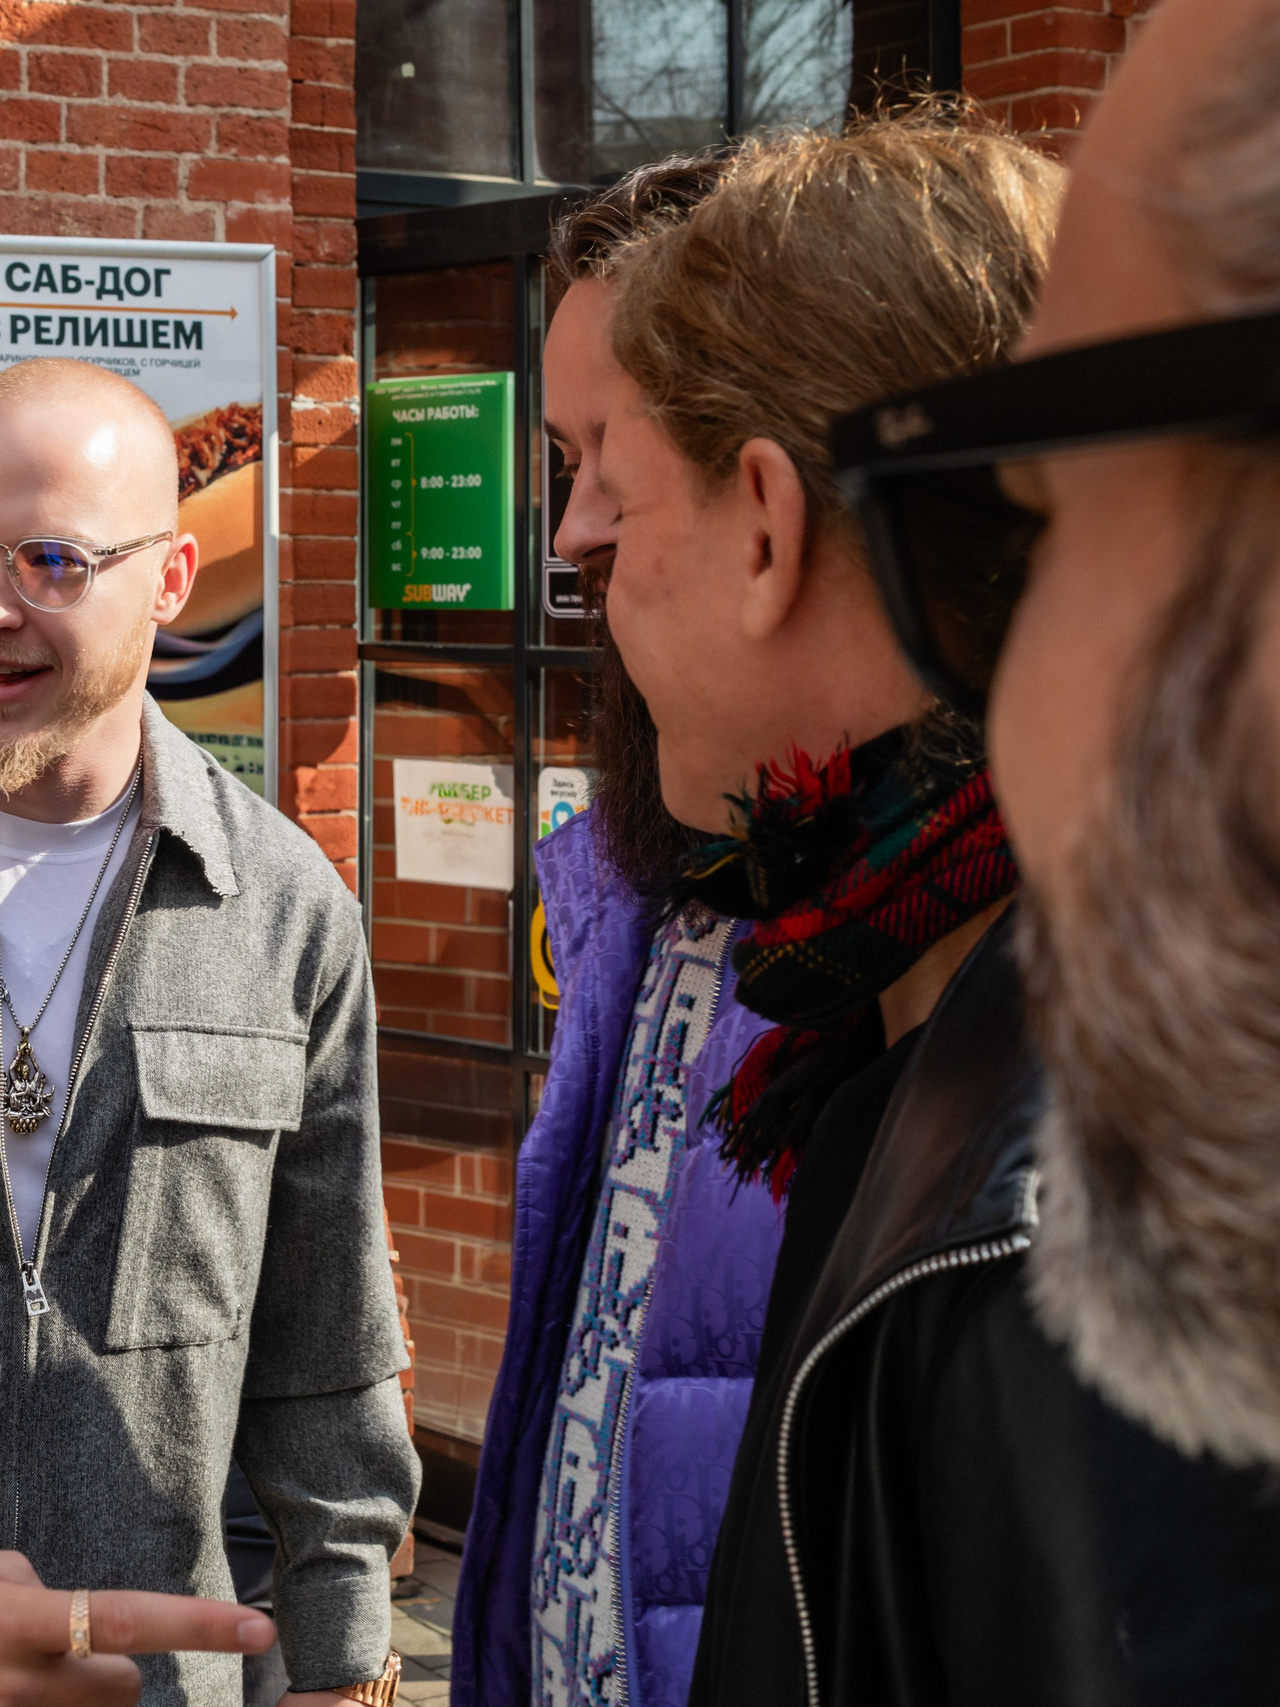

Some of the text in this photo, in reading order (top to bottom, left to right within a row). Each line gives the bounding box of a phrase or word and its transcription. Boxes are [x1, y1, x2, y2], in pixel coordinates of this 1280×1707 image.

[5, 262, 171, 300] САБ-ДОГ
[10, 314, 204, 350] РЕЛИШЕМ
[149, 357, 202, 369] ГОРЧИЦЕЙ
[392, 404, 480, 422] ЧАСЫ РАБОТЫ:
[420, 476, 444, 489] 8:00
[451, 474, 482, 488] 23:00
[421, 547, 444, 560] 9:00
[451, 546, 482, 560] 23:00
[401, 583, 472, 603] SUBWAY
